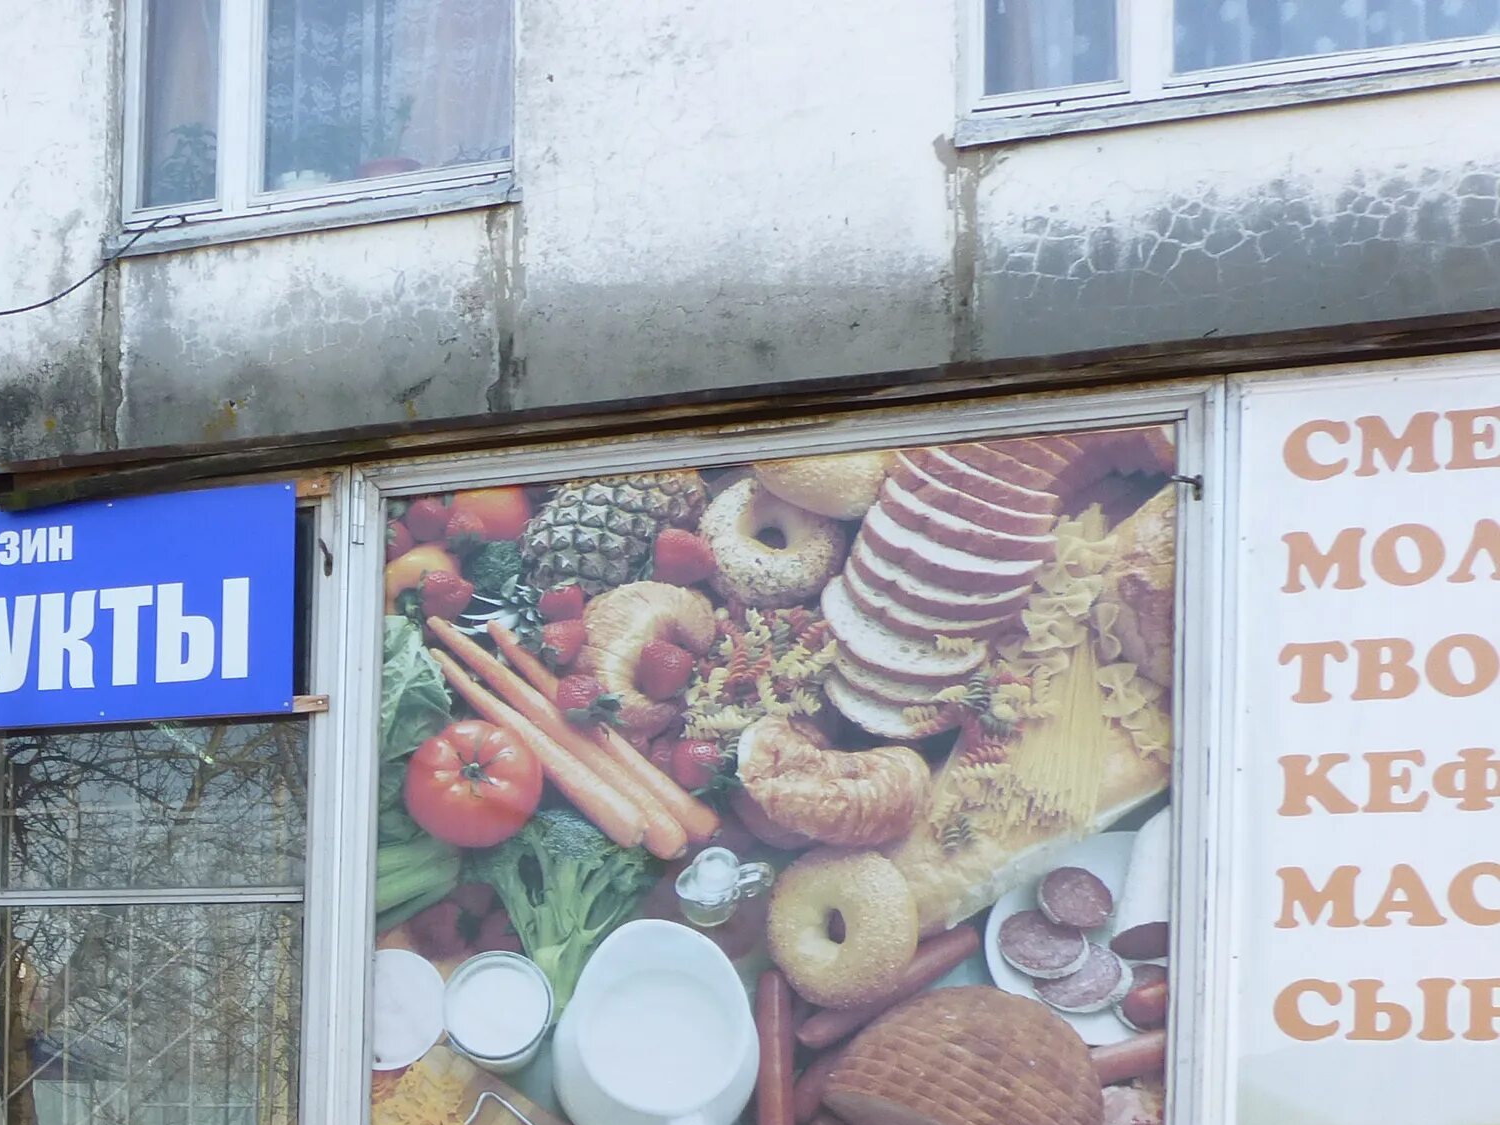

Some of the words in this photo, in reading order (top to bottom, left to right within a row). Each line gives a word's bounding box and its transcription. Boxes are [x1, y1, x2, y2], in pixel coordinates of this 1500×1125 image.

[1282, 408, 1500, 480] СМЕ
[1278, 633, 1500, 704] ТВО
[1277, 747, 1500, 817] КЕФ
[1274, 862, 1500, 929] МАС
